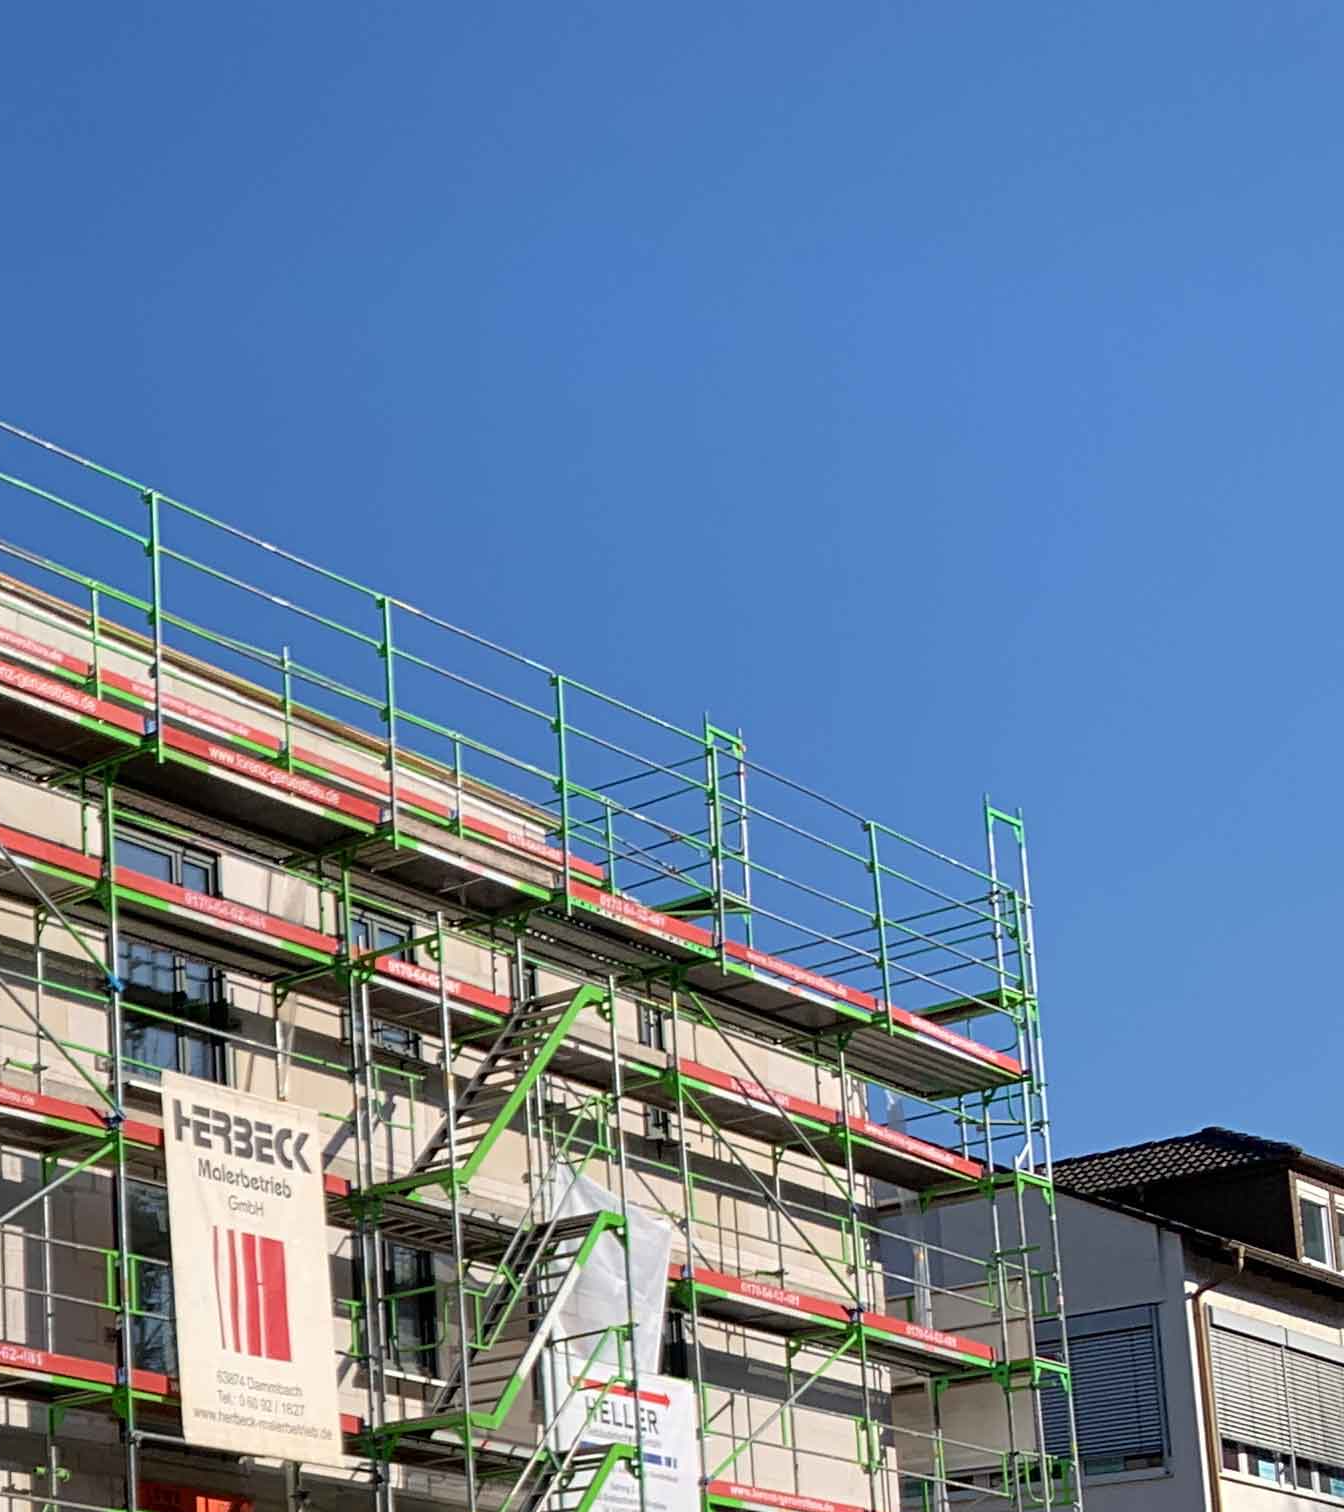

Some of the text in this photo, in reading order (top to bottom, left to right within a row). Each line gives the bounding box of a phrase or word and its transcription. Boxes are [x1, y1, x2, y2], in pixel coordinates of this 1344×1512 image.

[172, 1098, 312, 1174] HERBECK
[197, 1158, 292, 1200] Malerbetrieb
[228, 1195, 264, 1217] GmbH
